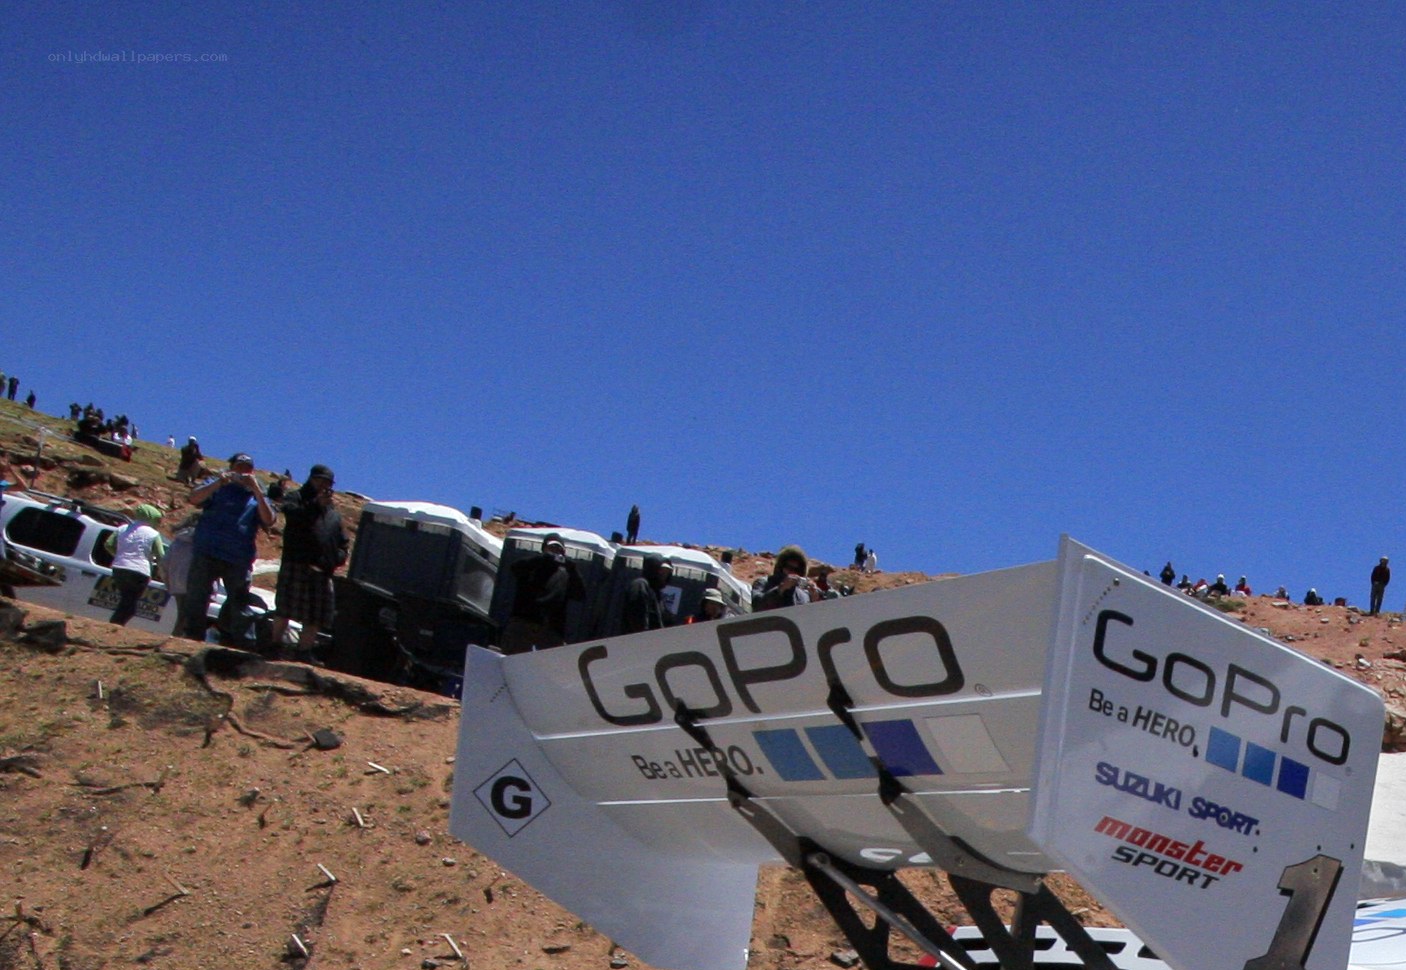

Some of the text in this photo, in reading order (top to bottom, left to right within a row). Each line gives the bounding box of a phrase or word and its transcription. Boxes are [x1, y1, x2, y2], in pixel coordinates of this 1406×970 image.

[578, 615, 965, 727] GoPro
[1092, 609, 1352, 766] GoPro
[1089, 688, 1114, 718] Be
[1117, 705, 1129, 724] a
[631, 744, 764, 780] Be a HERO.
[490, 775, 533, 820] G
[1095, 761, 1182, 811] SUZUKI
[1094, 815, 1244, 876] monster
[1111, 846, 1220, 890] SPORT
